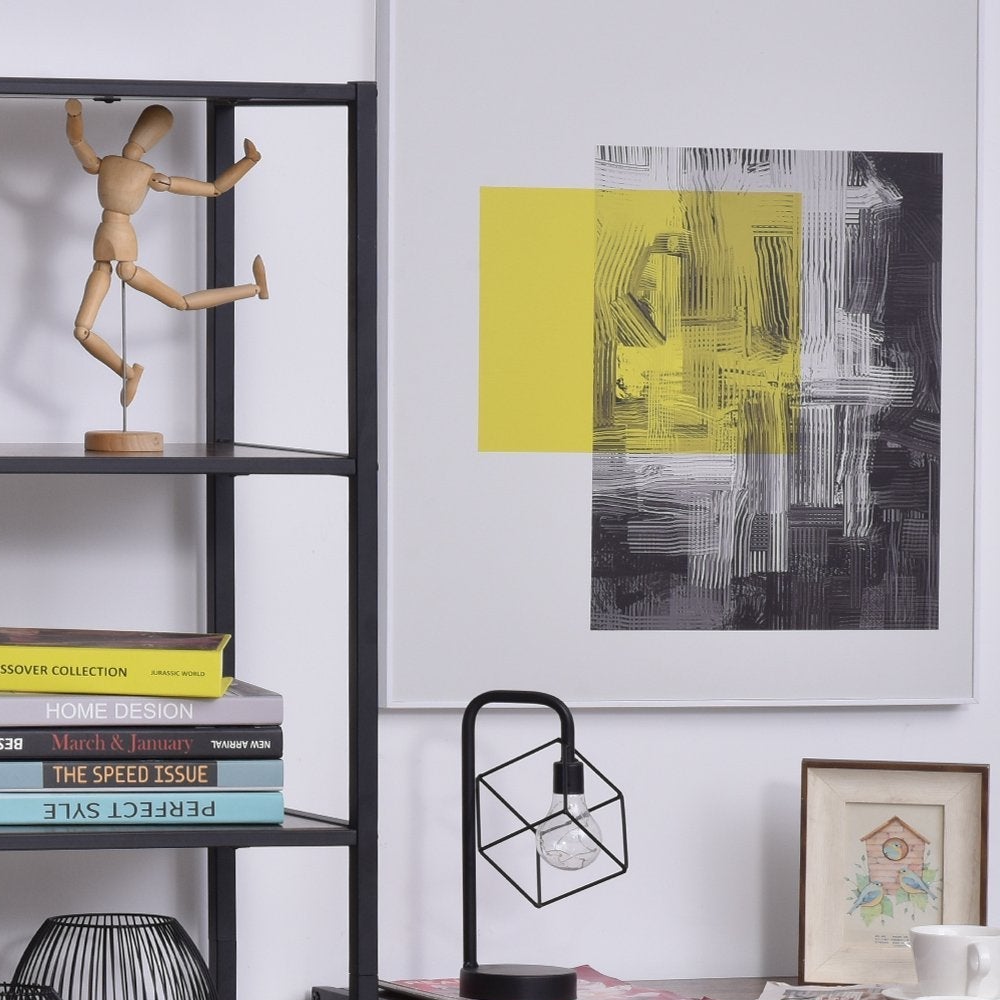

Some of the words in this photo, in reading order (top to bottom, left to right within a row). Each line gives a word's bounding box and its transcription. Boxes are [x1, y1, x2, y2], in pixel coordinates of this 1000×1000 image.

[51, 664, 128, 678] COLLECTION
[150, 669, 180, 677] JURASSIC
[182, 669, 206, 678] WORLD
[45, 702, 108, 720] HOME
[51, 733, 108, 751] March
[110, 733, 126, 751] &
[128, 733, 194, 755] January
[210, 739, 248, 749] ARRIVAL
[248, 739, 271, 749] NEW
[53, 765, 89, 784] THE
[92, 765, 149, 784] SPEED
[153, 765, 209, 784] ISSUE
[43, 801, 100, 820] SYLE
[108, 800, 216, 818] PERFECT
